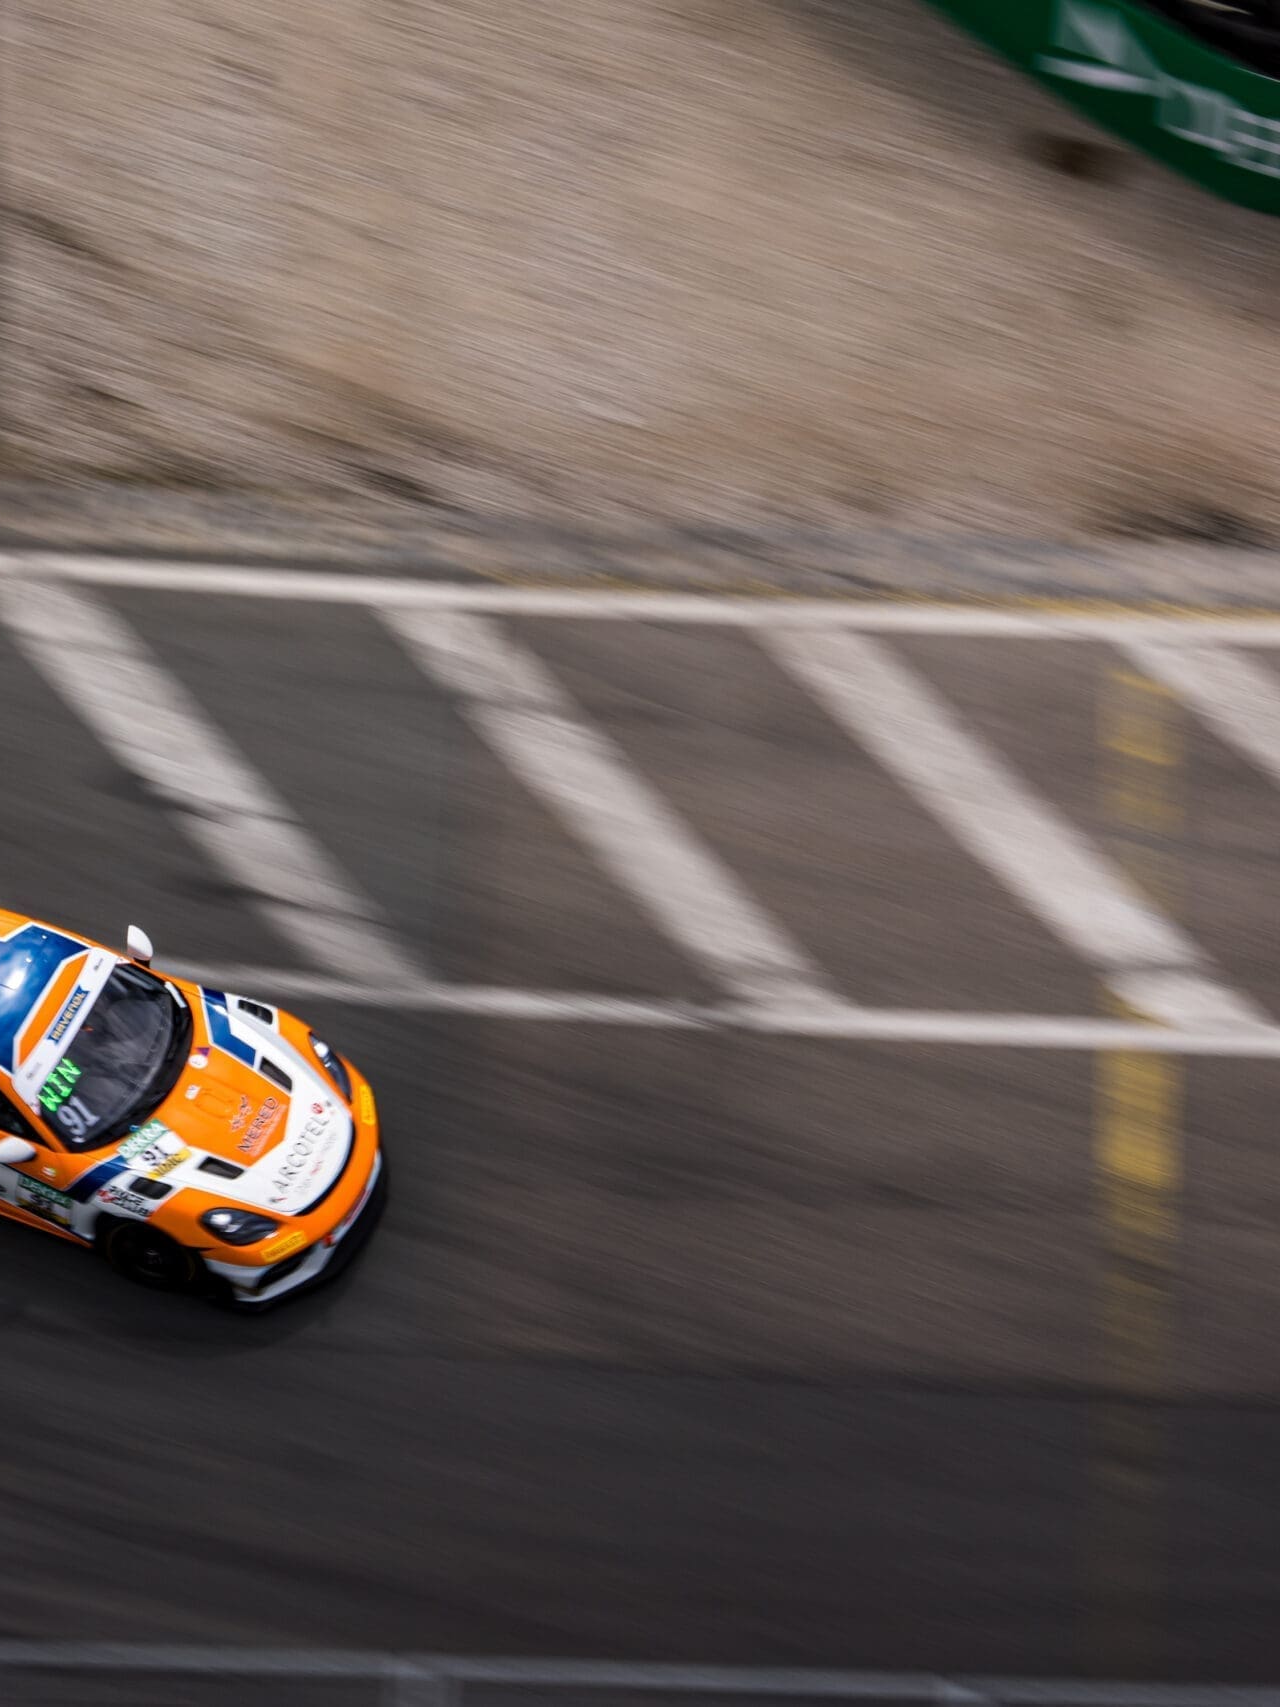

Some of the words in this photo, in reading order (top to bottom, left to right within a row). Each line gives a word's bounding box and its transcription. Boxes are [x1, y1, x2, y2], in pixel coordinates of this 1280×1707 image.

[51, 989, 85, 1041] RAVENOL
[37, 1058, 81, 1112] WIN
[57, 1095, 100, 1138] 91
[237, 1097, 278, 1152] MERED
[272, 1116, 329, 1194] ARCOTEL
